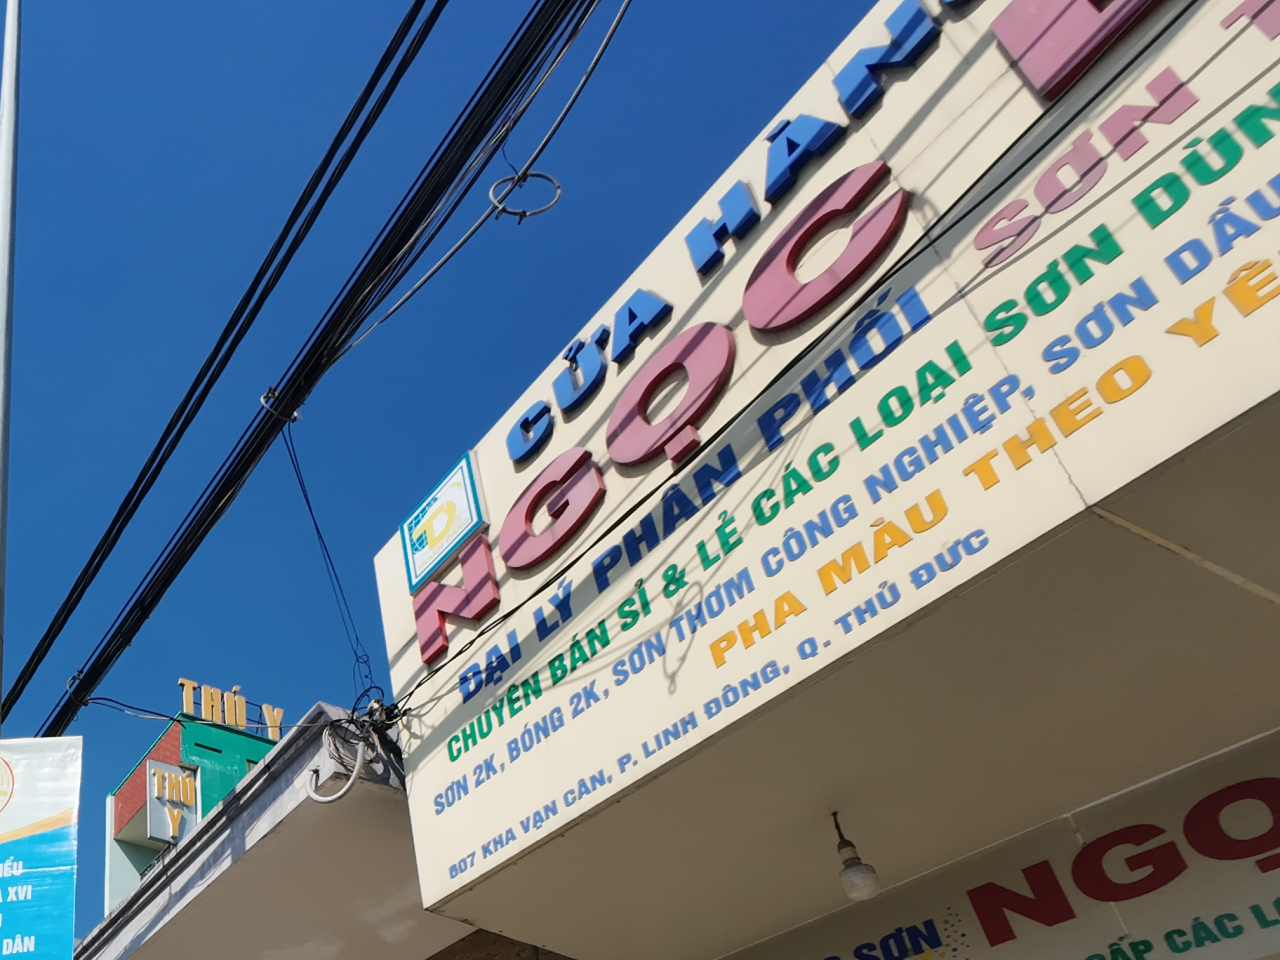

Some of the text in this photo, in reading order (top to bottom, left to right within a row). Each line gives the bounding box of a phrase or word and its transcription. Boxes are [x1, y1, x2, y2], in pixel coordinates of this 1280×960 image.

[506, 288, 673, 463] CỬA
[684, 0, 970, 276] HÀN
[973, 65, 1200, 268] SƠN
[412, 160, 910, 666] NGỌC
[447, 671, 542, 763] CHUYÊN
[548, 618, 611, 687] BÁN
[616, 577, 652, 632] SỈ
[662, 563, 690, 599] &
[696, 510, 744, 572] LẺ
[751, 442, 840, 526] CÁC
[848, 339, 973, 452] LOẠI
[983, 223, 1124, 347] SƠN
[458, 628, 523, 704] ĐẠI
[532, 577, 574, 643] LÝ
[591, 443, 742, 594] PHÂN
[756, 285, 933, 453] PHỐI
[709, 247, 1280, 668] PHA MÀU THEO YÊ
[434, 774, 469, 816] SƠN
[473, 753, 505, 788] 2K,
[507, 706, 565, 763] BÓNG
[569, 679, 609, 719] 2K,
[612, 631, 666, 687] SƠN
[669, 567, 755, 643] THƠM
[760, 494, 859, 577] CÔNG
[863, 373, 1036, 505] NGHIỆP,
[1042, 276, 1160, 375] SƠN
[151, 768, 196, 806] THÚ
[166, 806, 183, 838] Y
[178, 677, 284, 740] THÚ Y
[448, 851, 476, 879] 607
[481, 828, 517, 860] KHA
[519, 799, 559, 830] VẠN
[563, 769, 613, 807] CÂN,
[617, 753, 638, 774] P.
[641, 711, 698, 759] LINH
[703, 660, 790, 719] ĐÔNG,
[796, 637, 832, 661] Q.
[834, 580, 902, 634] THỦ
[2, 934, 36, 955] DÂN
[6, 884, 32, 903] XVI
[1163, 912, 1244, 954] CÁC
